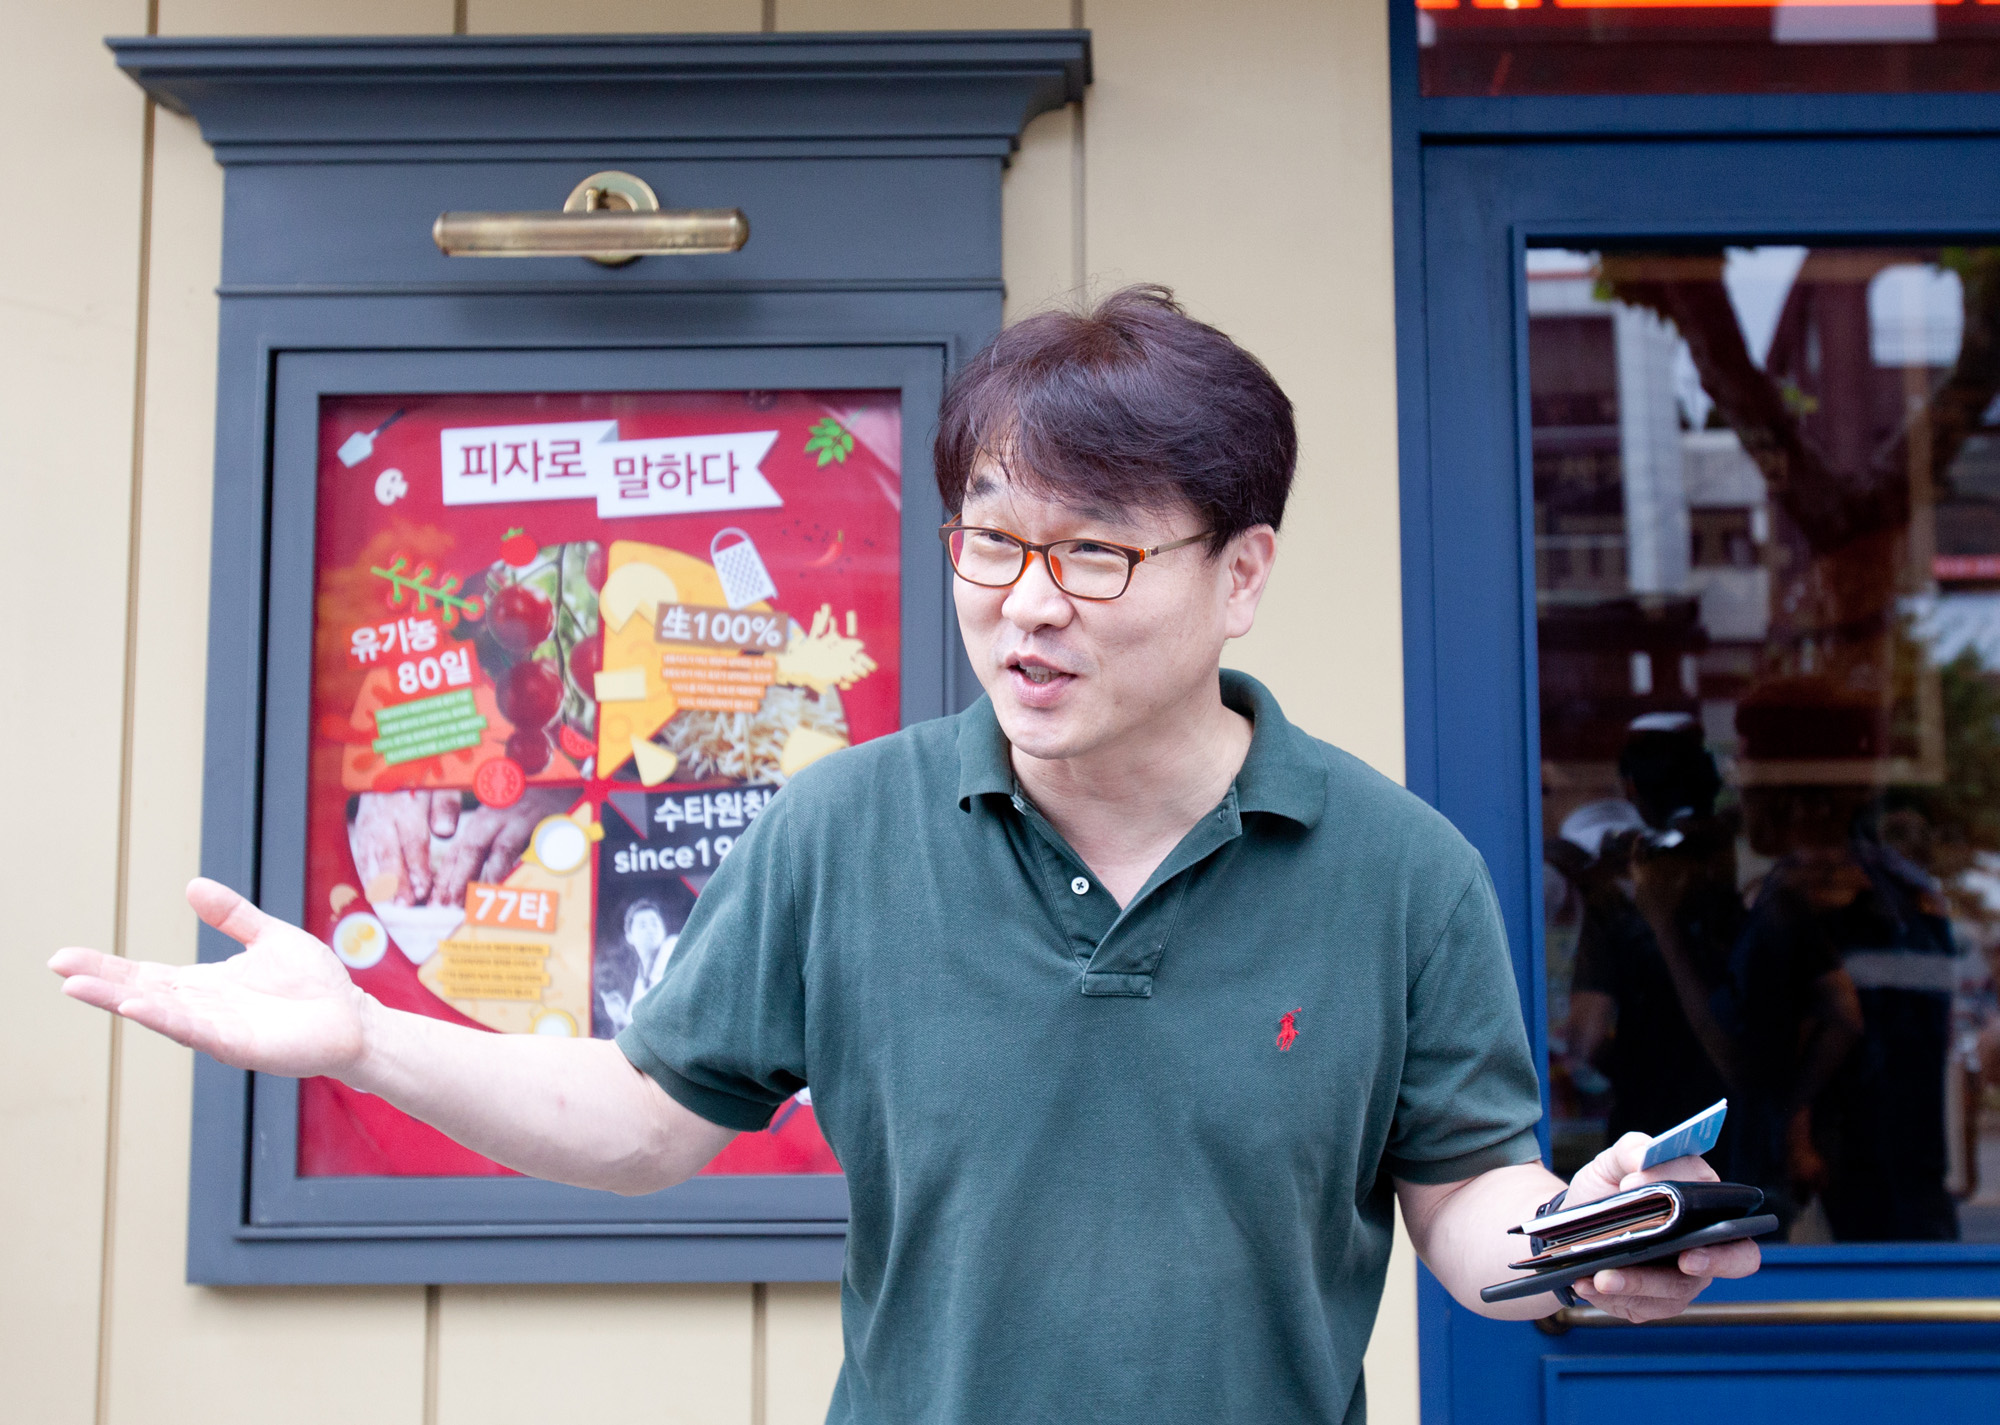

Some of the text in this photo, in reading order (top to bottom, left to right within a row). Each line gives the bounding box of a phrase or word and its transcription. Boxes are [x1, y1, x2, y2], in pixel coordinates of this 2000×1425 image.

[459, 439, 740, 499] 피자로 말하다
[350, 617, 438, 663] 유기농
[661, 606, 783, 648] 生100%
[397, 647, 472, 694] 80일
[614, 835, 741, 874] since19
[475, 888, 551, 929] 77타
